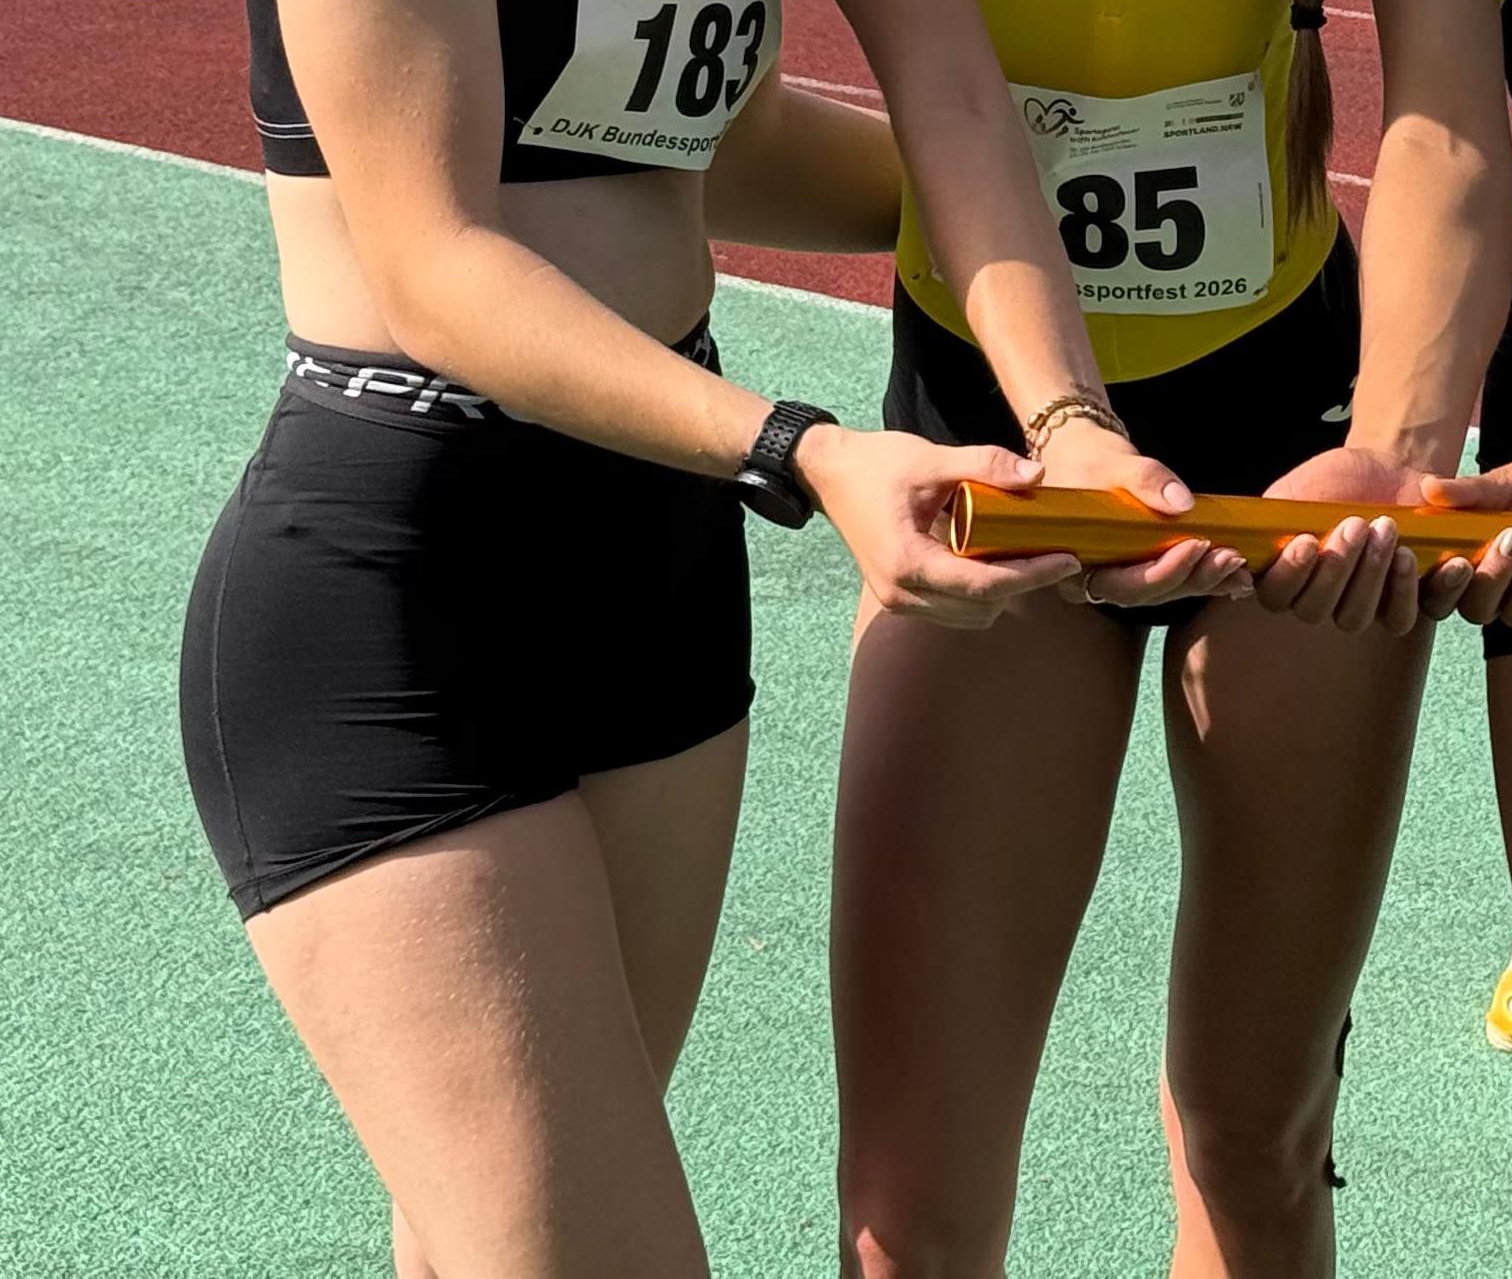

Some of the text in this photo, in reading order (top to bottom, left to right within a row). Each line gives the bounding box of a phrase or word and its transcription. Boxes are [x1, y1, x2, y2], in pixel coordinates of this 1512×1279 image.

[624, 0, 767, 118] 183
[550, 118, 721, 156] DJK Bundesspor
[1056, 165, 1206, 271] 85
[1075, 277, 1248, 302] sportfest 2026
